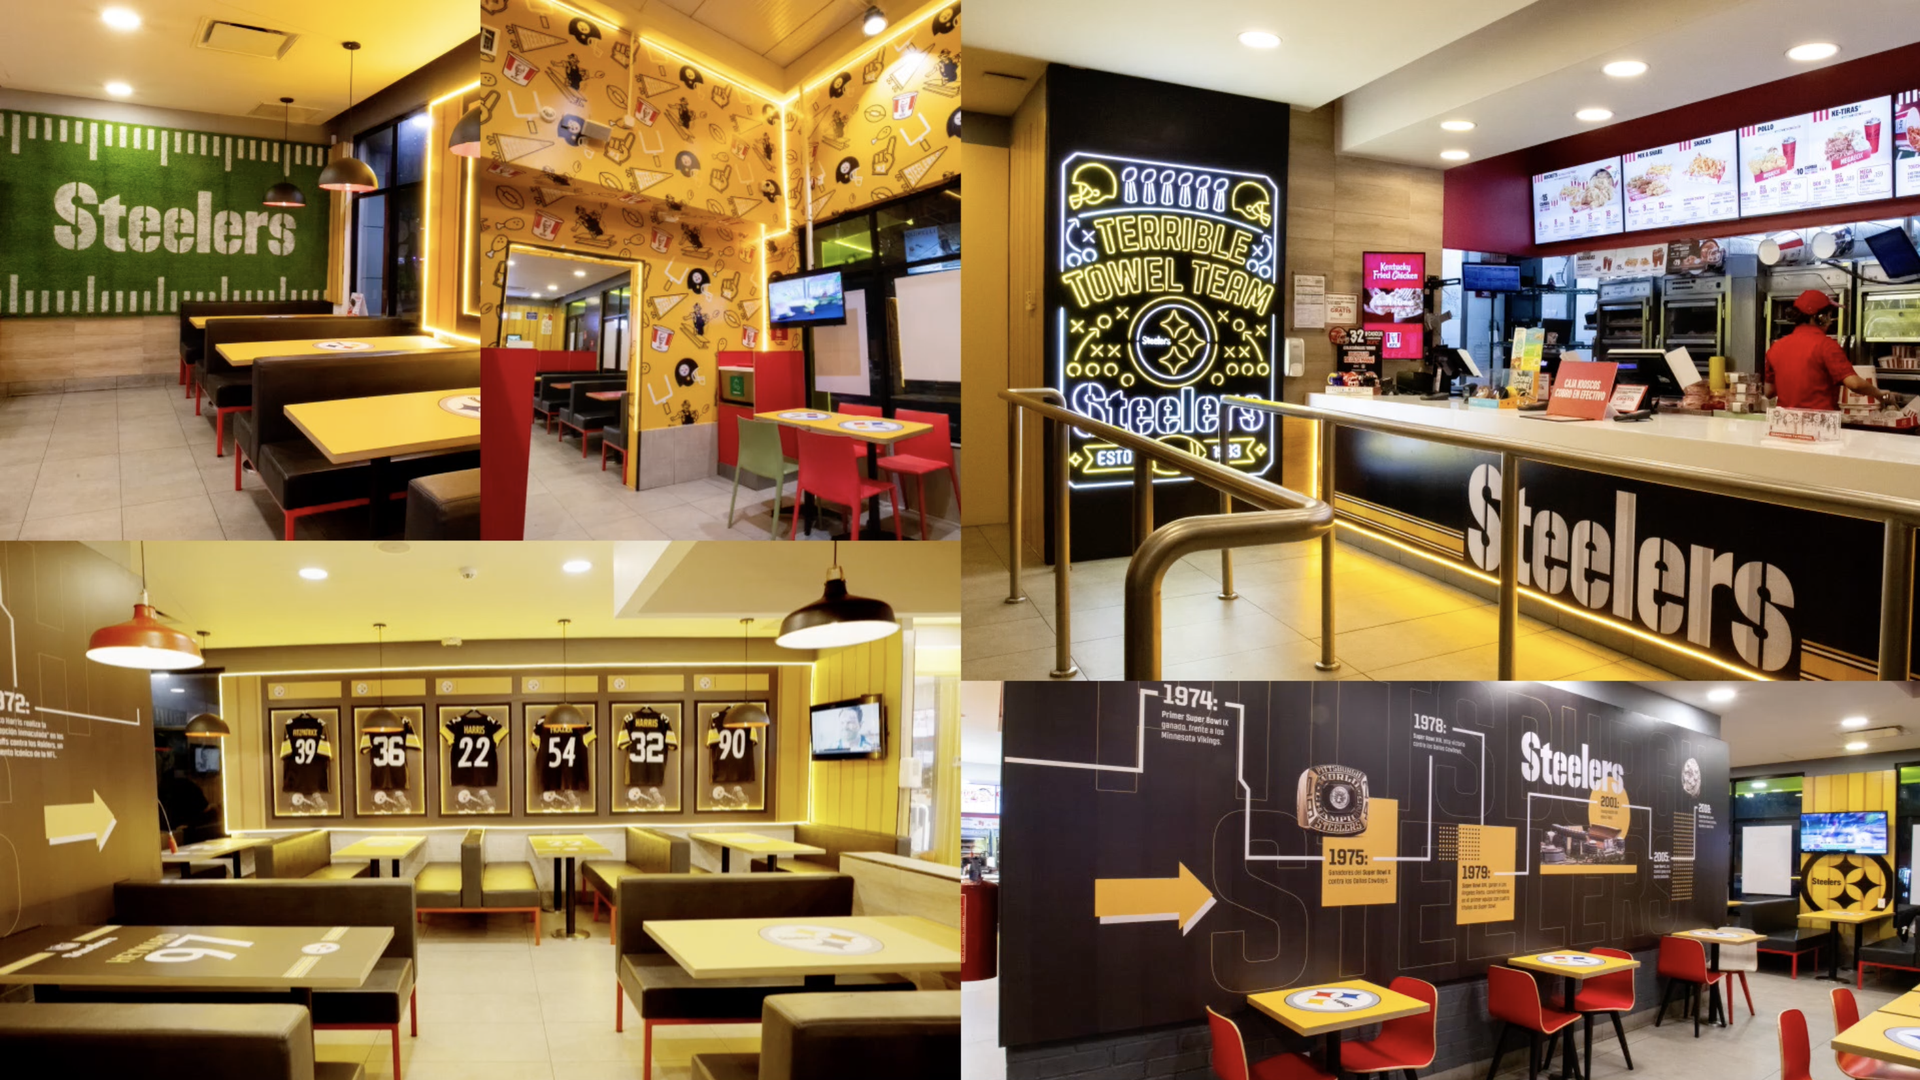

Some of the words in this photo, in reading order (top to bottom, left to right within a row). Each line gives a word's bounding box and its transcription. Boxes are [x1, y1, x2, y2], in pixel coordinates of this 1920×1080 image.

[1831, 105, 1859, 117] KE-TIRAS
[1757, 124, 1774, 132] POLLO
[1693, 138, 1711, 147] SNACKS
[53, 181, 297, 256] Steelers
[1093, 215, 1253, 265] TERRIBLE
[1373, 270, 1391, 280] Fried
[1392, 270, 1418, 280] Chicken
[1380, 262, 1411, 273] Kentucky
[1061, 257, 1184, 308] TOWEL
[1192, 259, 1274, 316] TEAM
[1142, 335, 1171, 346] Steelers
[1349, 329, 1365, 344] 32
[1564, 379, 1577, 388] CAJA
[1577, 379, 1601, 390] KIOSCOS
[1554, 388, 1572, 398] COBRO
[1572, 390, 1580, 398] EN
[1580, 390, 1606, 401] EFECTIVO
[1467, 463, 1795, 672] Steelers
[1163, 683, 1218, 711] 1974:
[635, 718, 658, 728] HARRIS
[1161, 710, 1185, 720] Primer
[1186, 714, 1205, 723] Super
[1206, 717, 1221, 725] Bowl
[1414, 713, 1446, 734] 1978:
[463, 725, 485, 735] HARRIS
[1189, 725, 1208, 733] frente
[719, 729, 746, 760] 90
[1161, 731, 1196, 742] Minnesota
[1197, 735, 1222, 746] Vikings.
[295, 739, 316, 764] 39
[373, 735, 405, 767] 36
[458, 736, 490, 768] 22
[549, 736, 576, 768] 54
[629, 732, 664, 763] 32
[1521, 731, 1624, 794] Steelers
[1601, 796, 1619, 808] 2001:
[1315, 819, 1362, 832] STEELERS
[1329, 848, 1368, 865] 1975:
[1462, 865, 1490, 879] 1979:
[1811, 878, 1842, 886] Steelers
[144, 933, 254, 963] 97
